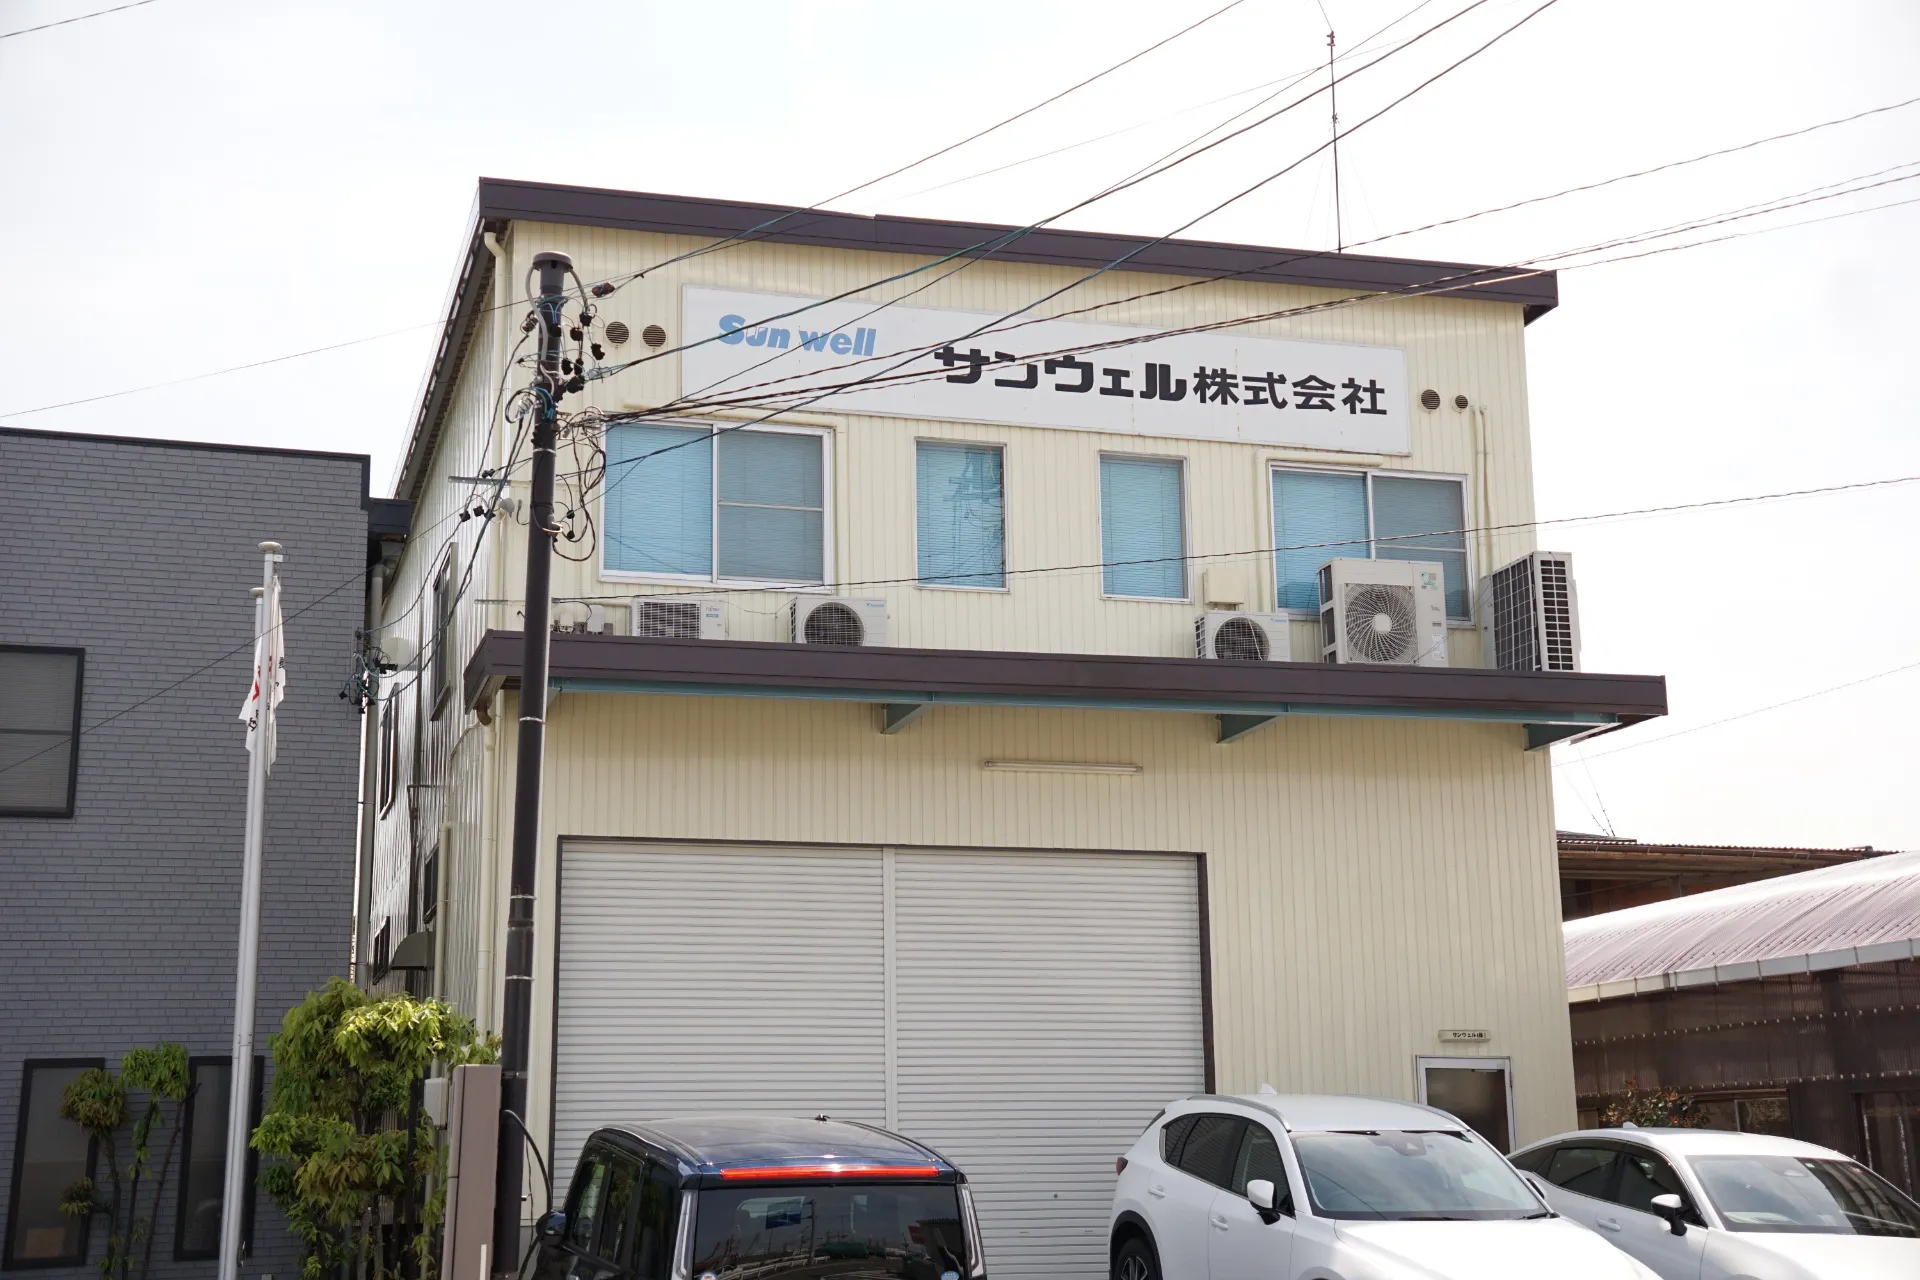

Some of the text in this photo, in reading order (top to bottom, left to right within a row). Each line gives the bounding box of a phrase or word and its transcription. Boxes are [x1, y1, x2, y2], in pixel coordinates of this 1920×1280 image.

[719, 314, 877, 356] Sun well
[934, 346, 1388, 415] サンウェル株式会社
